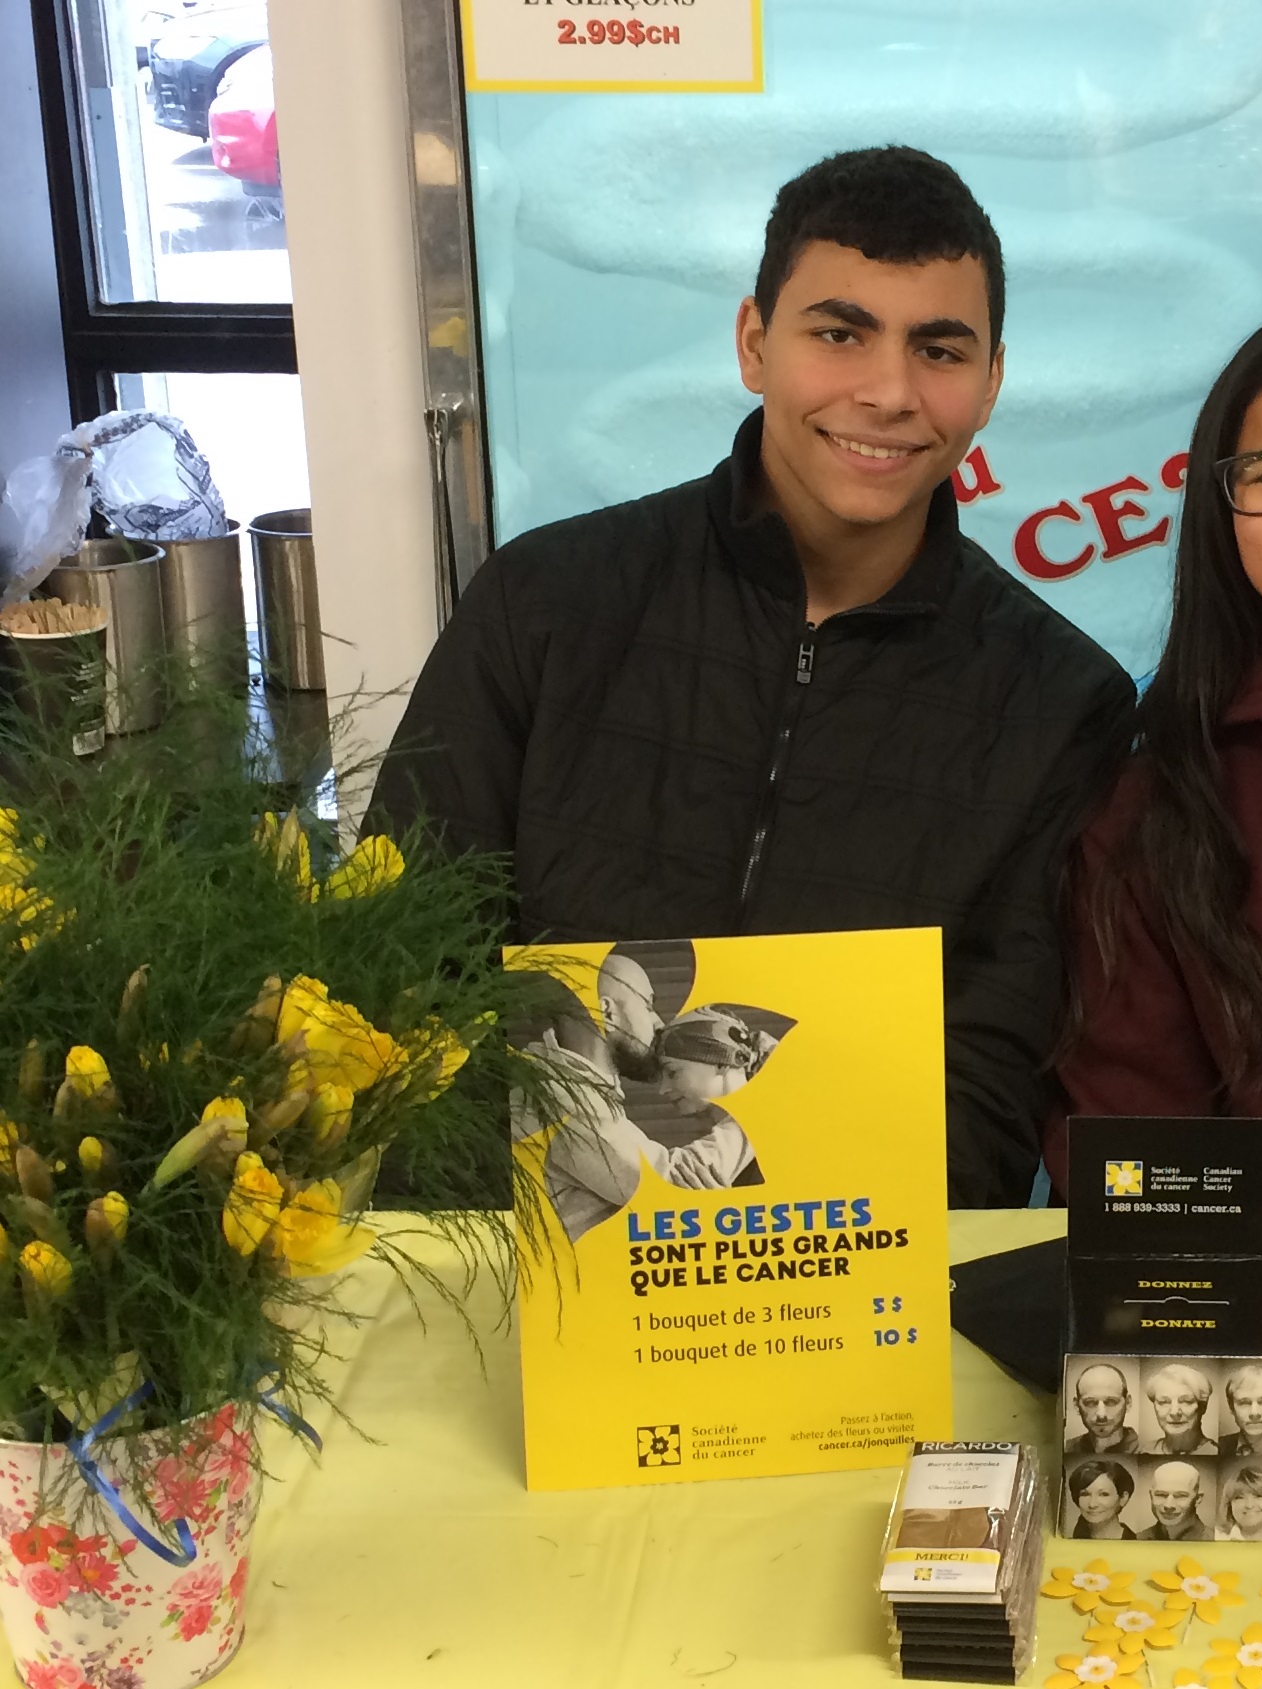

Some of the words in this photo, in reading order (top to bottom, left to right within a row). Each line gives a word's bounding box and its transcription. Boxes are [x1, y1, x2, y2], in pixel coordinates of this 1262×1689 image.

[1203, 1166, 1243, 1175] Canadian
[1203, 1175, 1232, 1183] Cancer
[1150, 1182, 1162, 1190] du
[1163, 1183, 1191, 1191] cancer
[1191, 1204, 1242, 1213] cancer.ca
[628, 1208, 702, 1242] LES
[714, 1198, 872, 1236] GESTES
[628, 1242, 707, 1266] SONT
[715, 1237, 785, 1261] PLUS
[792, 1228, 909, 1255] GRANDS
[630, 1267, 688, 1297] QUE
[696, 1265, 728, 1286] LE
[736, 1256, 851, 1283] CANCER
[1137, 1280, 1213, 1289] DONNEZ
[873, 1297, 885, 1315] 5
[891, 1296, 903, 1313] $
[632, 1315, 642, 1332] 1
[649, 1308, 728, 1332] bouquet
[733, 1306, 756, 1325] de
[762, 1306, 773, 1323] 3
[780, 1303, 832, 1322] fleurs
[1140, 1319, 1217, 1328] DONATE
[874, 1328, 900, 1347] 10
[906, 1327, 918, 1344] $
[634, 1348, 643, 1364] 1
[650, 1340, 729, 1364] bouquet
[734, 1339, 757, 1357] de
[764, 1338, 786, 1355] 10
[792, 1335, 844, 1353] fleurs
[840, 1415, 870, 1426] Passez
[691, 1424, 738, 1437] Société
[790, 1429, 824, 1441] achetez
[827, 1427, 843, 1439] des
[845, 1425, 871, 1438] fleurs
[873, 1426, 885, 1436] ou
[887, 1423, 915, 1435] visitez
[691, 1434, 767, 1449] canadienne
[818, 1434, 916, 1452] cancer.ca/jonquilles
[921, 1441, 1013, 1451] RICARDO
[692, 1448, 709, 1460] du
[712, 1446, 756, 1459] cancer
[914, 1552, 969, 1561] MERCI!
